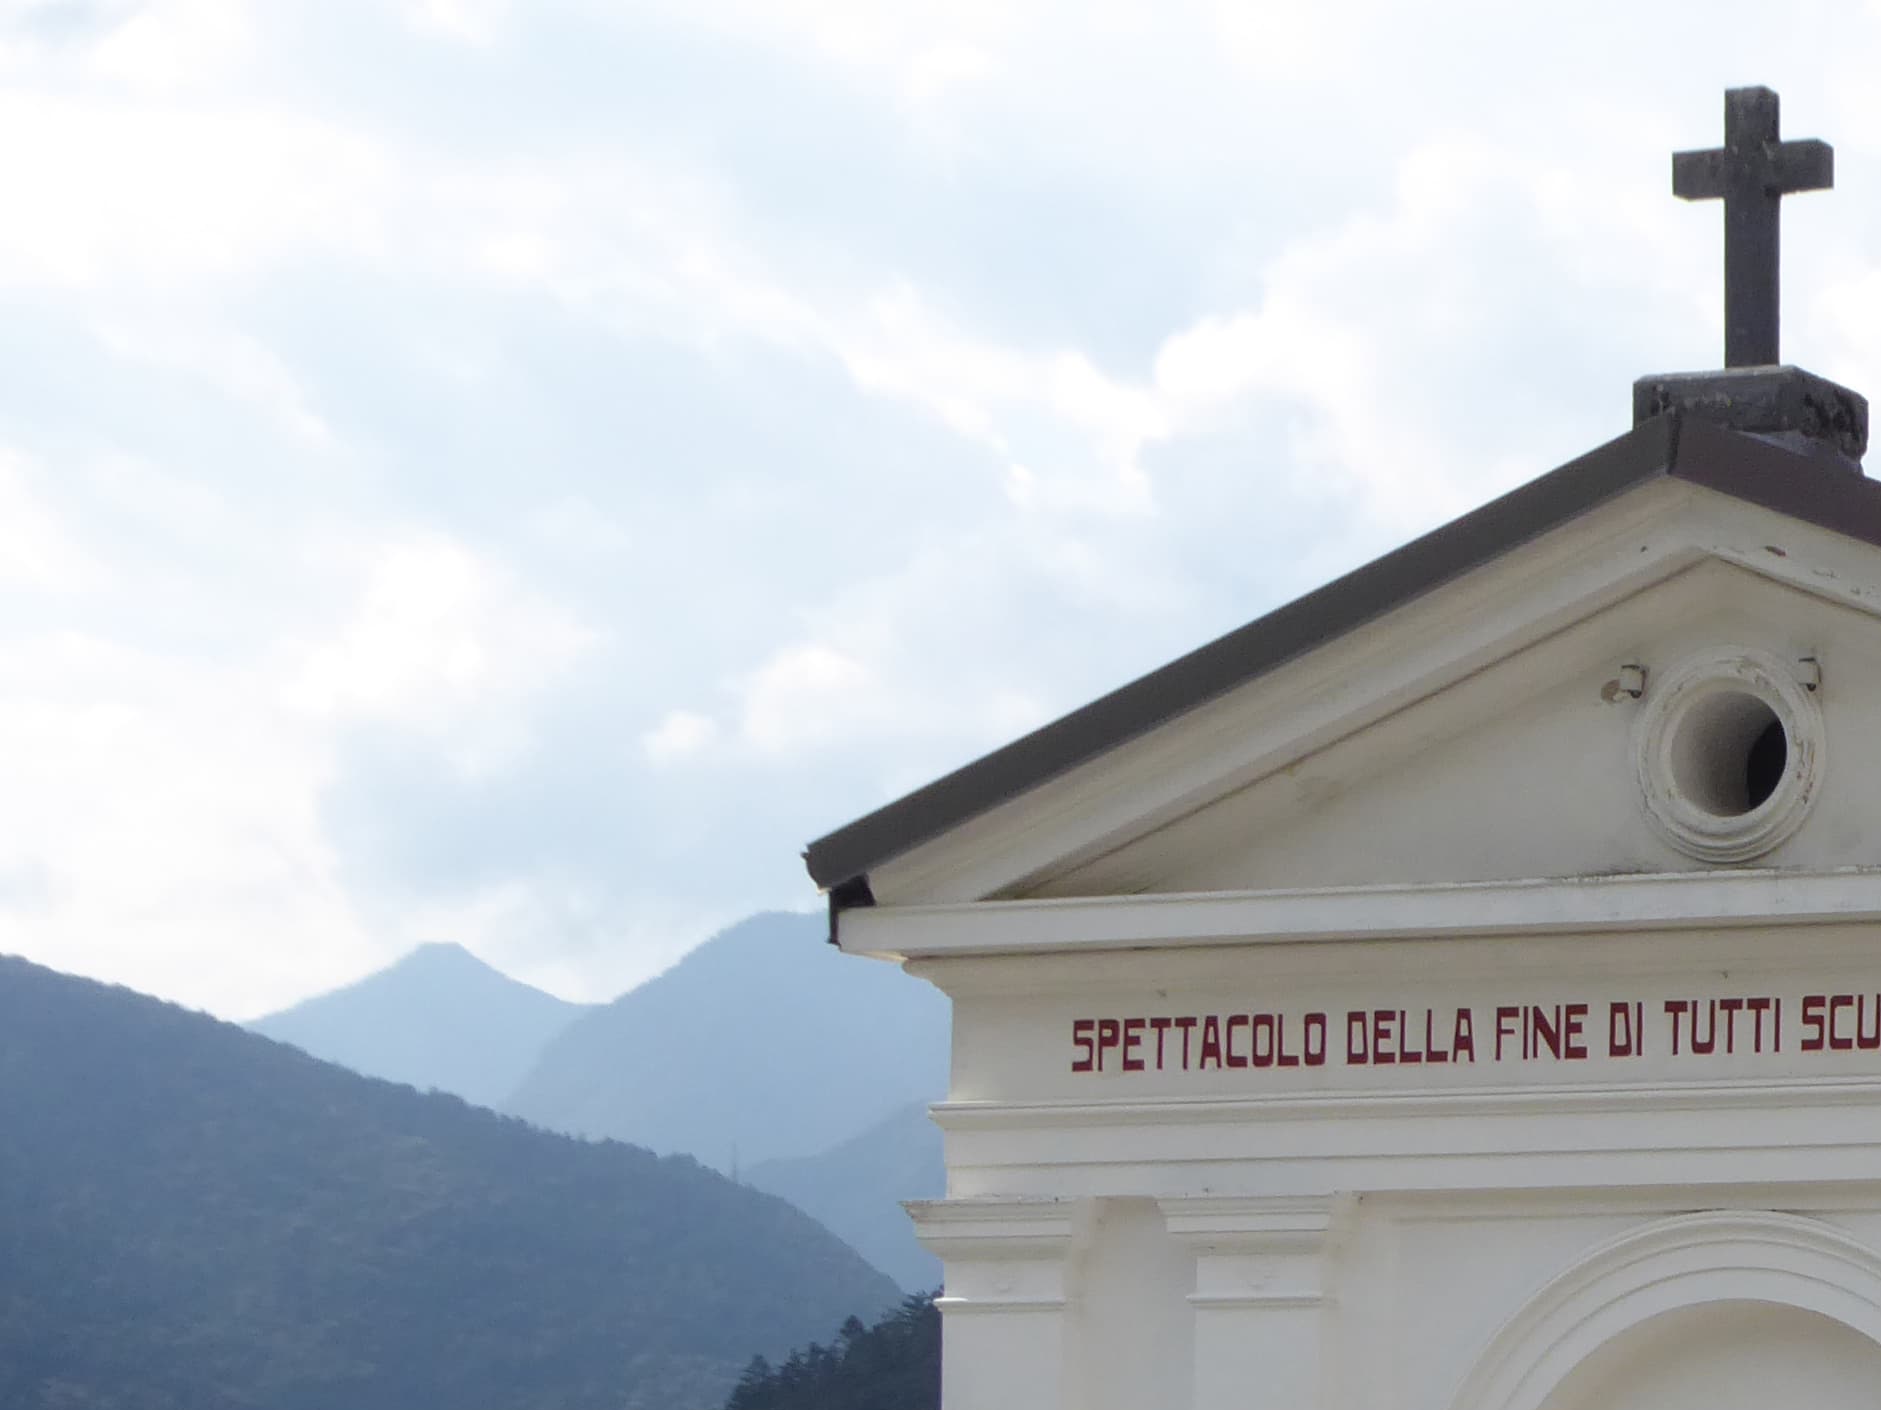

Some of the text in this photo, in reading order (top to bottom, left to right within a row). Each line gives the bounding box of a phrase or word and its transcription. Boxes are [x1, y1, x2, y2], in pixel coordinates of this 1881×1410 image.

[1072, 1013, 1328, 1073] SPETTACOLO
[1347, 1008, 1475, 1065] DELLA
[1496, 1004, 1589, 1061] FINE
[1610, 1002, 1643, 1058] DI
[1665, 998, 1782, 1055] TUTTI
